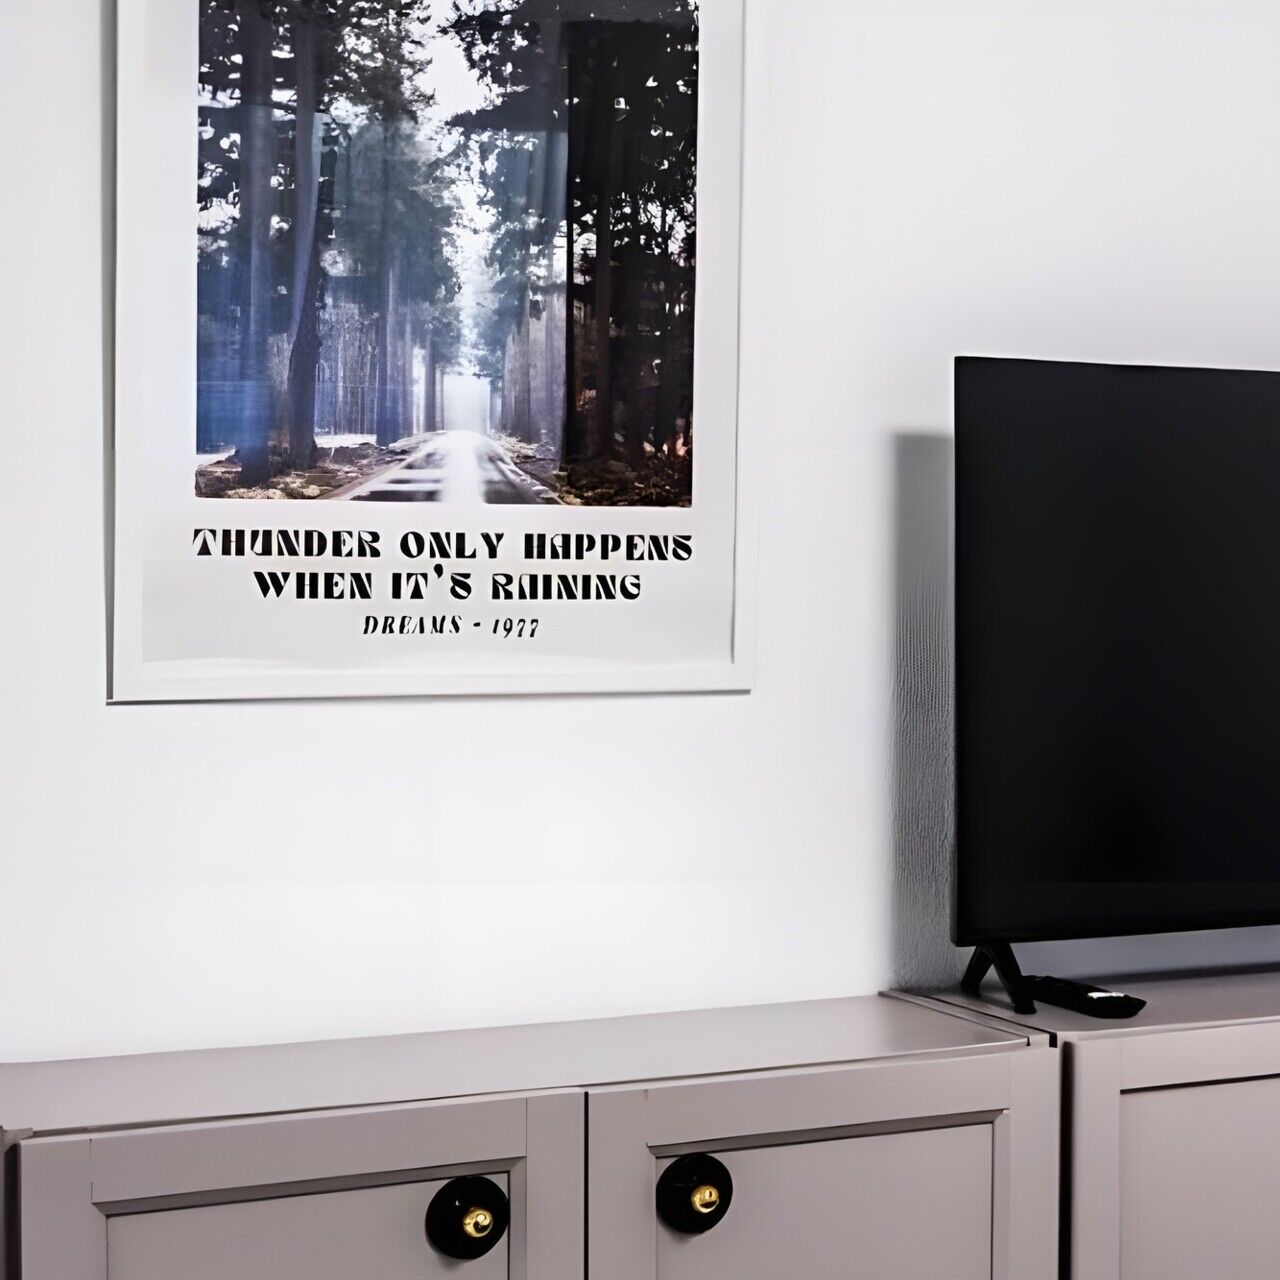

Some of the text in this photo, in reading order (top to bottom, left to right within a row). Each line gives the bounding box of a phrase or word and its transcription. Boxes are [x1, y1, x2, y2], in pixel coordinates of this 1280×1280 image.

[192, 528, 694, 562] THUNDER ONLY HAPPENS
[253, 563, 642, 601] WHEN IT'S RAINING
[362, 614, 463, 636] DREAMS
[491, 617, 540, 639] 1977
